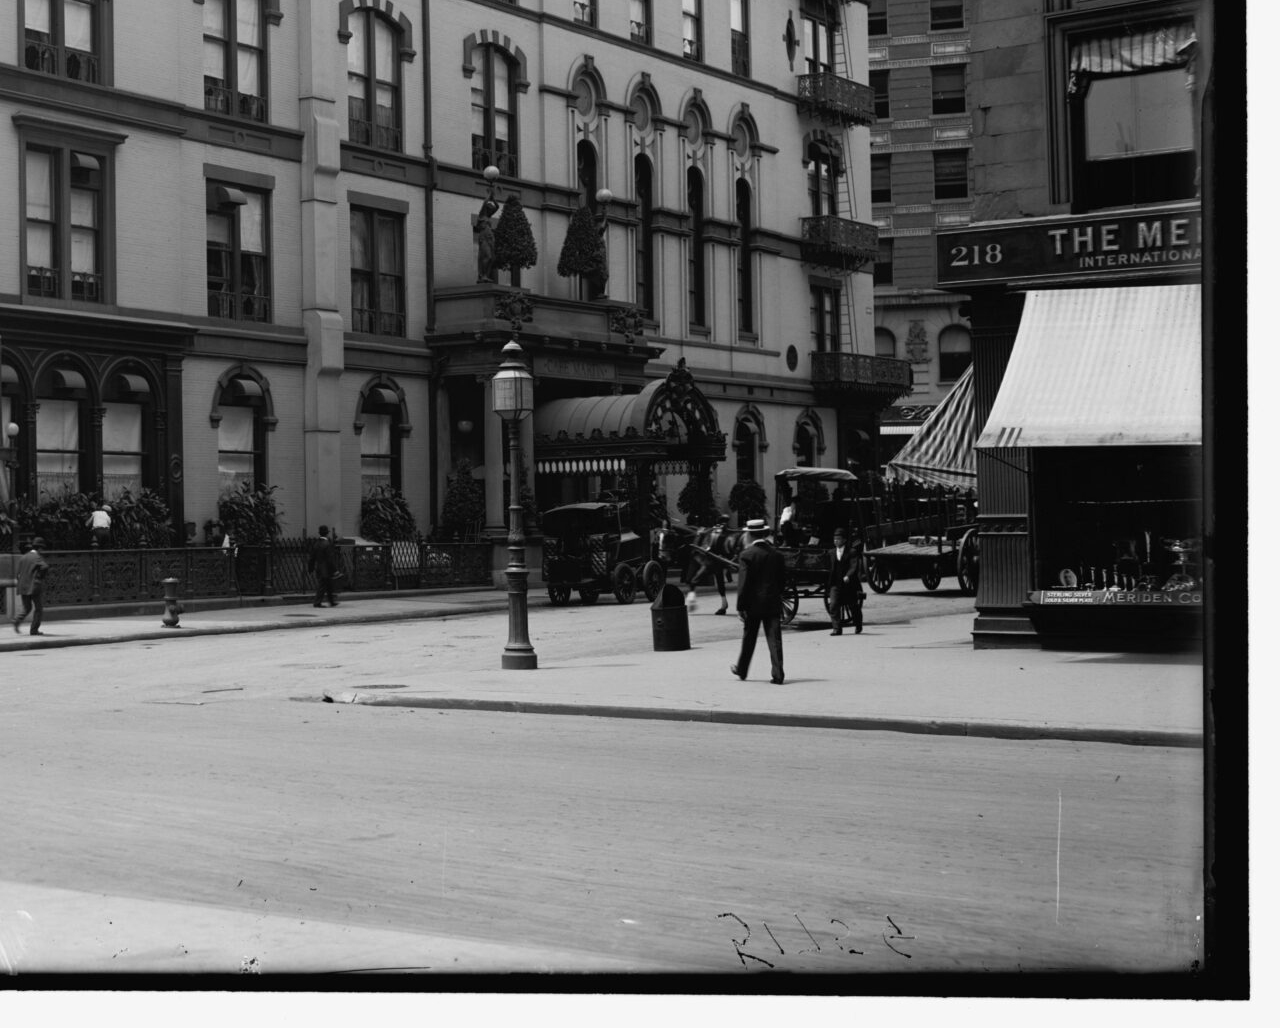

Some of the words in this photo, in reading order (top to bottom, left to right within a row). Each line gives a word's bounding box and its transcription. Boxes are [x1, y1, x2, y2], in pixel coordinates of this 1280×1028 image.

[1048, 223, 1120, 256] THE
[1136, 217, 1202, 249] ME
[949, 244, 1003, 267] 218
[1103, 592, 1172, 603] MERIDEN
